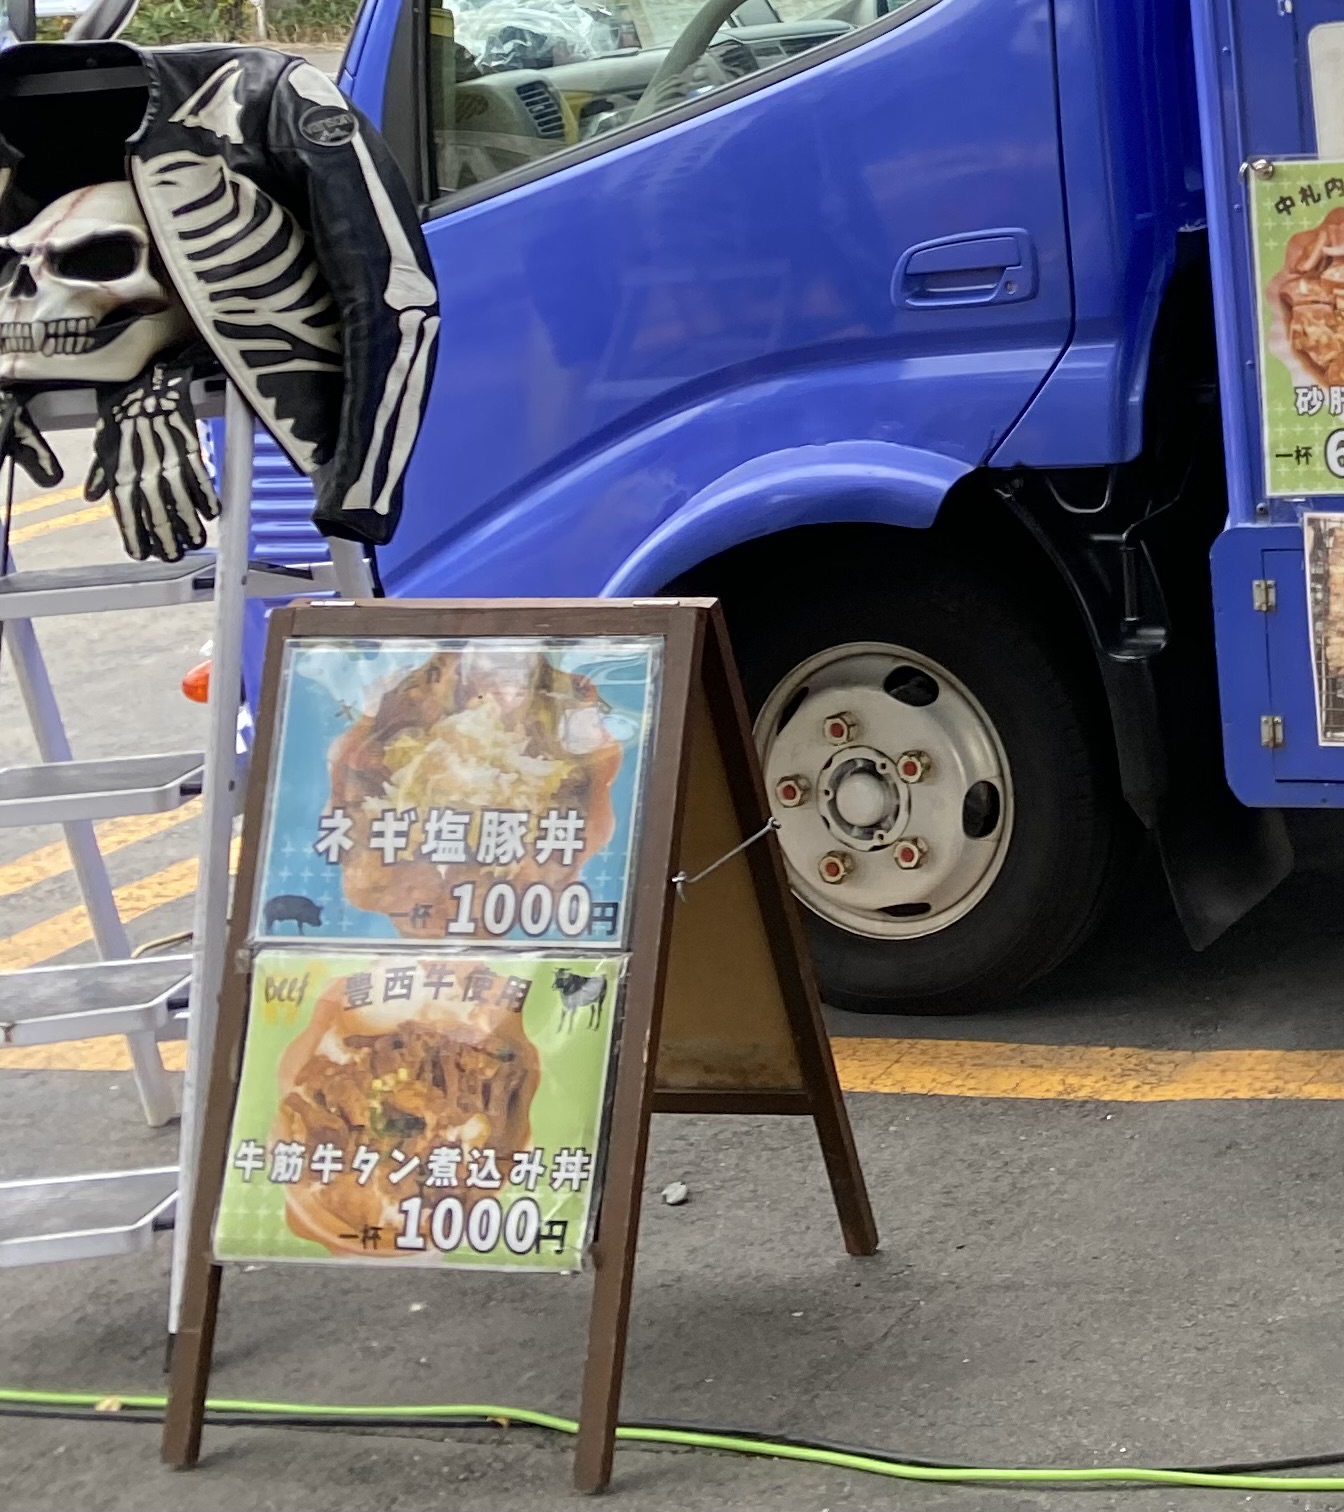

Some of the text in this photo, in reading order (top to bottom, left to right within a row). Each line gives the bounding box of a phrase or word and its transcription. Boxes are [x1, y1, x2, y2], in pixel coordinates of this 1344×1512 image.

[1275, 445, 1313, 466] 一杯
[314, 808, 585, 867] ネギ塩豚丼
[389, 902, 433, 928] 一杯
[343, 962, 532, 1013] 豊西牛使用
[233, 1138, 593, 1192] 牛筋牛タン煮込み丼
[339, 1225, 382, 1250] 一杯
